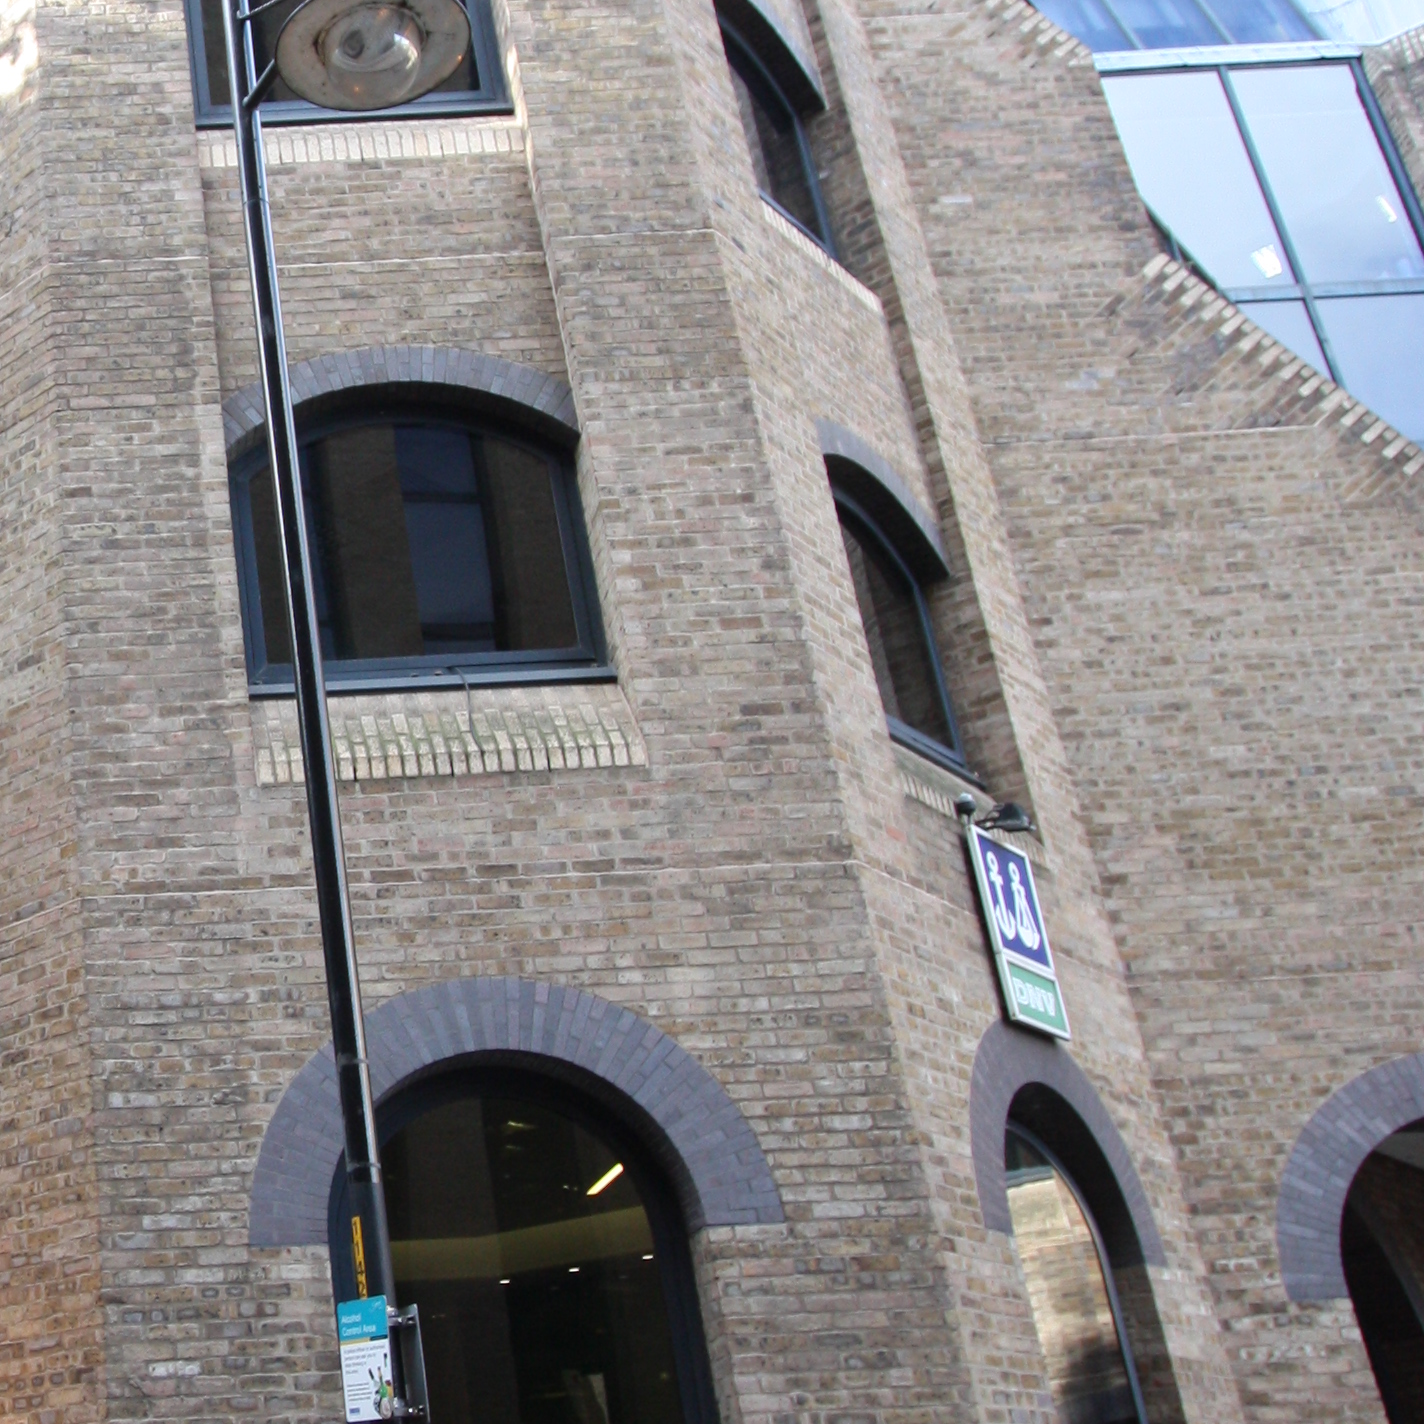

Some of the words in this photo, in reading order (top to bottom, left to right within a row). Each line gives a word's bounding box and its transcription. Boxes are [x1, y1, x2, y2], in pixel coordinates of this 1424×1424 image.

[1012, 976, 1056, 1017] DNV
[341, 1313, 361, 1324] Alcohol
[342, 1325, 362, 1336] Control
[363, 1324, 376, 1333] Area
